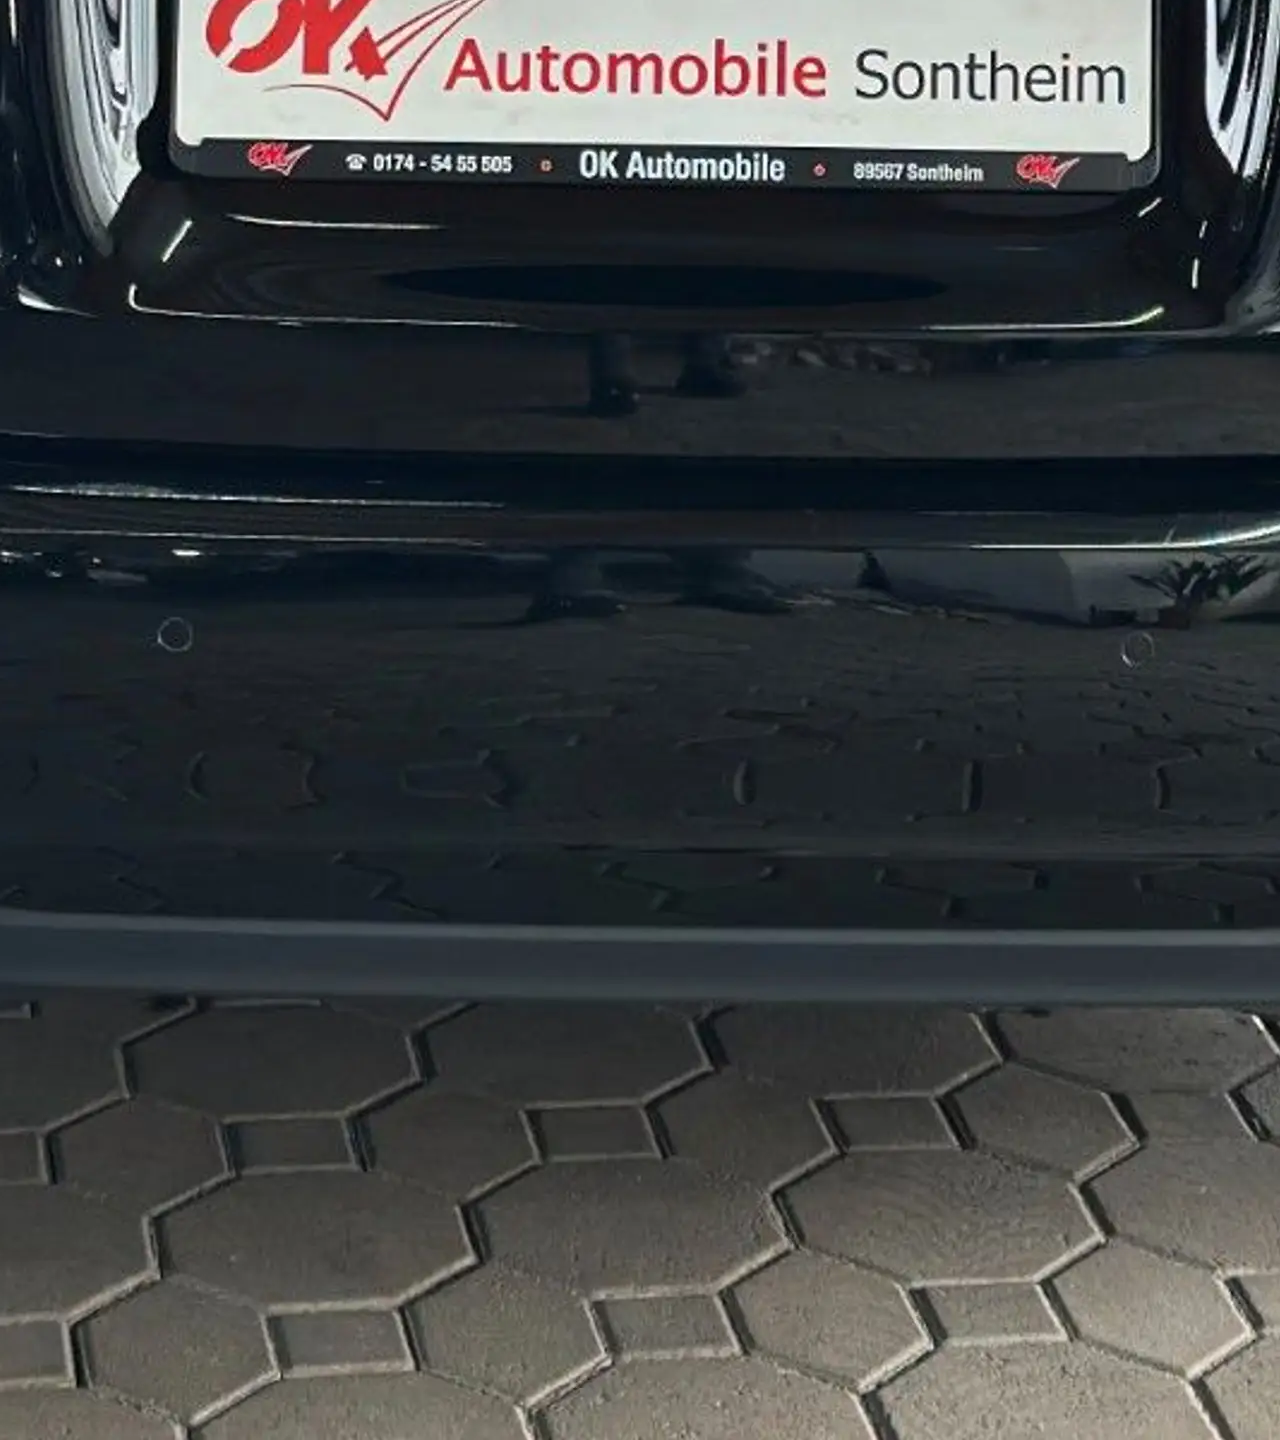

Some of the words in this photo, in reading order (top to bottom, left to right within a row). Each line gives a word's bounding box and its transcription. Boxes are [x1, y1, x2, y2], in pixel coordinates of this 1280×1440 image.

[443, 38, 827, 98] Automobile
[854, 47, 1127, 105] Sontheim
[372, 153, 415, 172] 0174
[430, 154, 453, 172] 54
[579, 149, 620, 179] OK
[625, 150, 787, 182] Automobile
[906, 163, 985, 182] Sontheim
